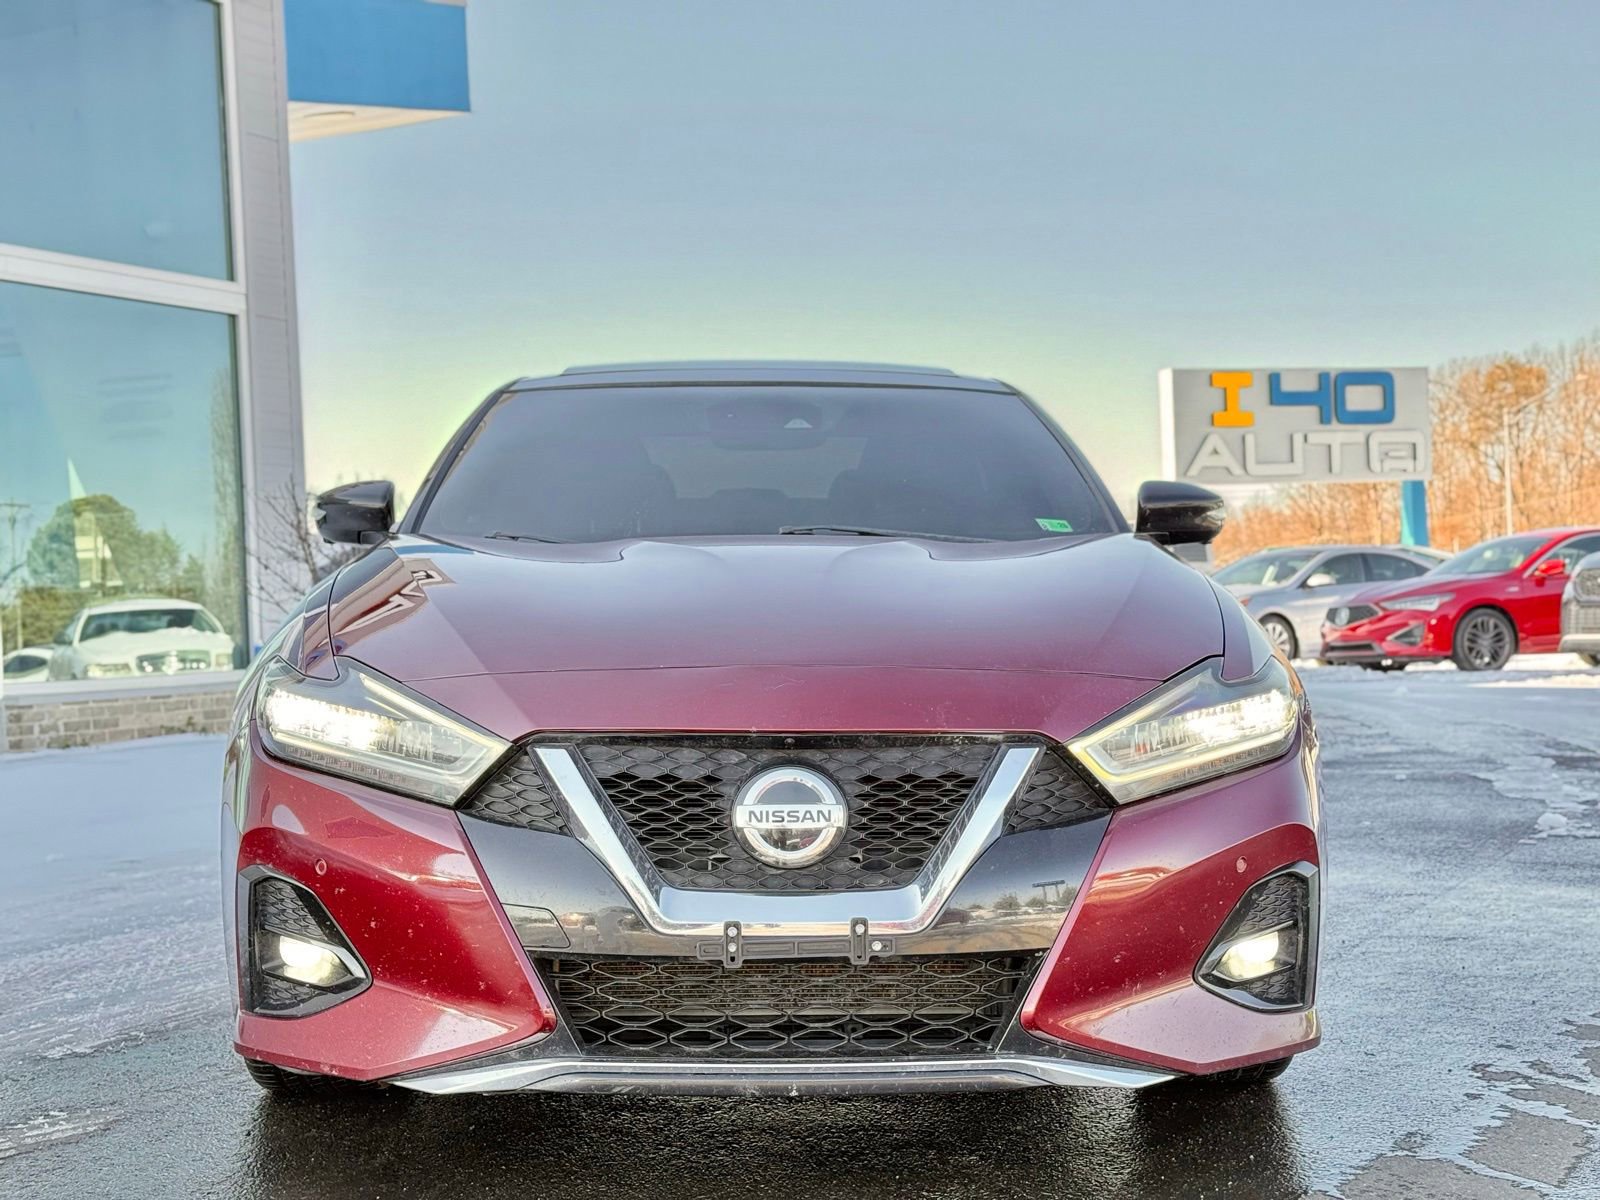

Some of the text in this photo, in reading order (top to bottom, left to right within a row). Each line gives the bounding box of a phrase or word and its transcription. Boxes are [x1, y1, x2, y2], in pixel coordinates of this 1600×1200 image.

[1211, 371, 1395, 427] I 40
[748, 809, 832, 823] NISSAN
